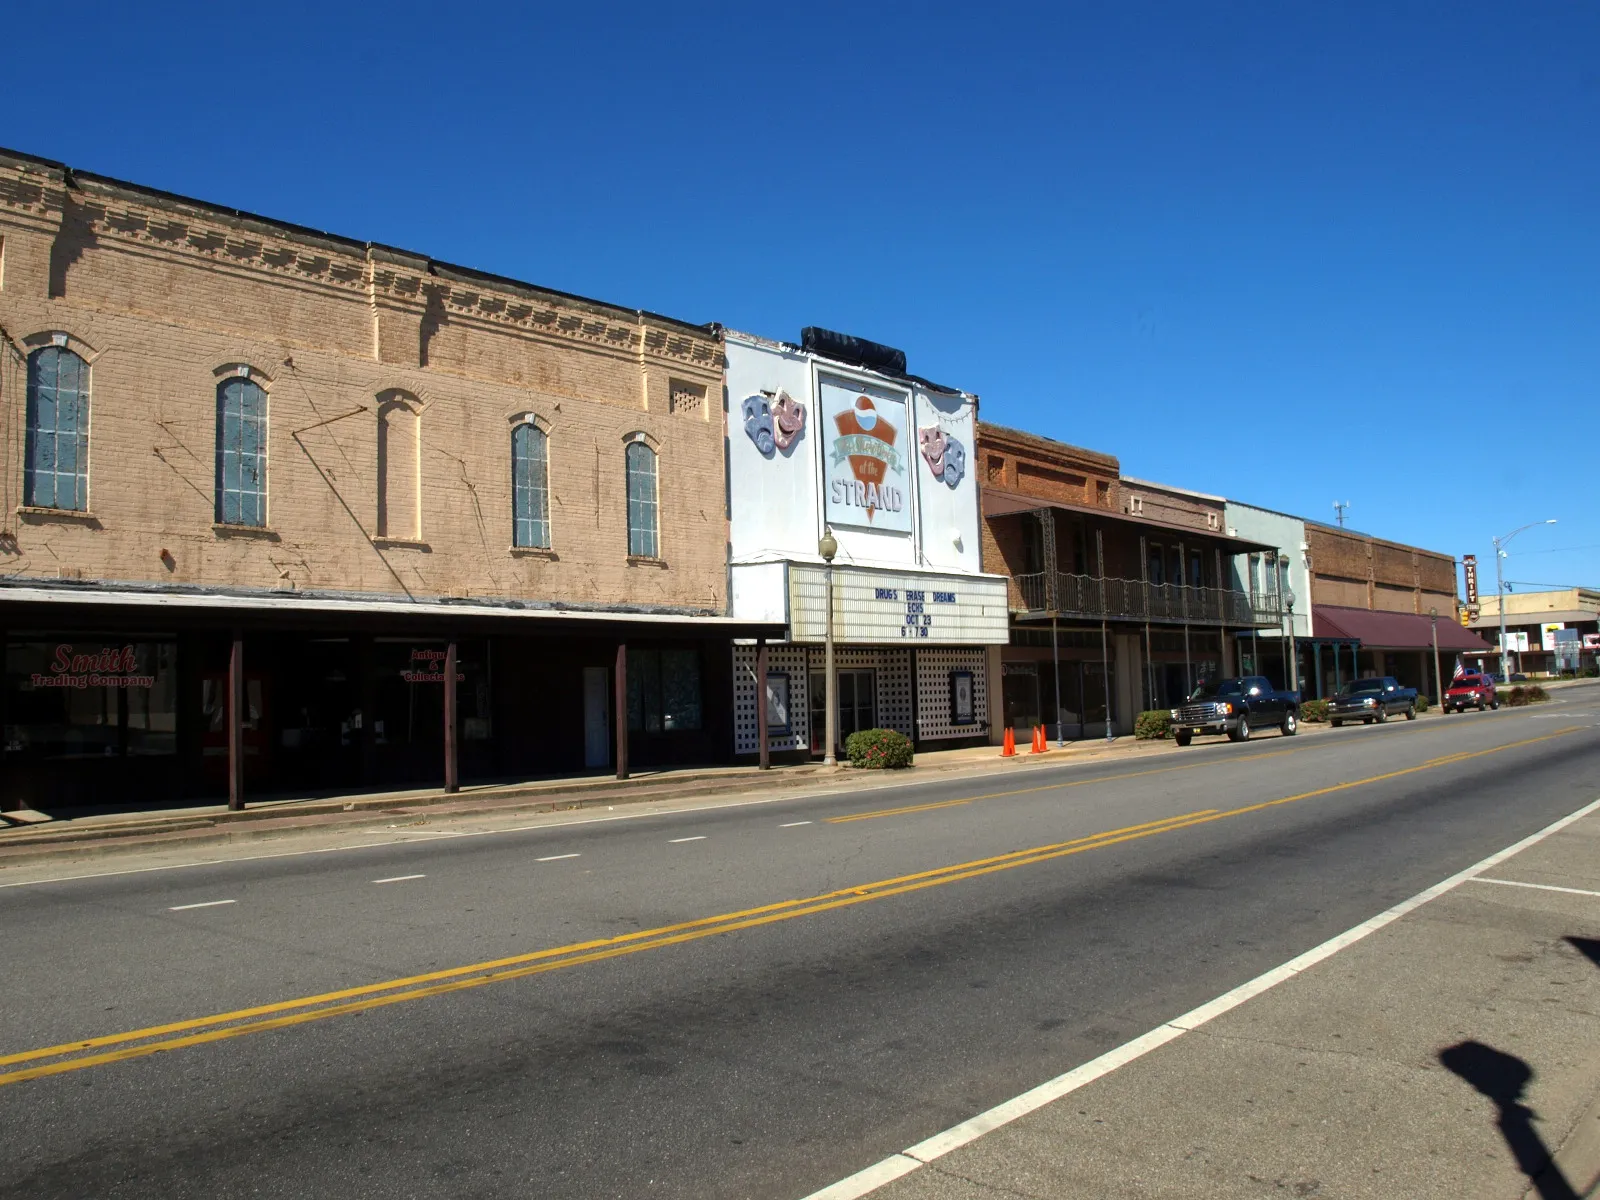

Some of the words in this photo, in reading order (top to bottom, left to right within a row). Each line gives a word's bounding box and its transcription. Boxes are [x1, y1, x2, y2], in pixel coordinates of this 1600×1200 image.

[859, 462, 867, 475] of
[868, 462, 878, 477] the
[831, 479, 903, 513] STRAND
[1467, 566, 1476, 602] THRIFT
[875, 588, 898, 600] DRUGS
[906, 591, 925, 602] ERASE
[933, 592, 956, 603] DREAMS
[908, 602, 924, 614] ECHS
[906, 614, 919, 625] OCT
[923, 615, 932, 626] 23
[901, 626, 906, 636] 6
[50, 644, 137, 673] Smith
[412, 650, 448, 660] Antique
[429, 660, 438, 671] &
[31, 674, 88, 688] Trading
[88, 674, 154, 688] Company
[404, 672, 465, 682] Collectaes
